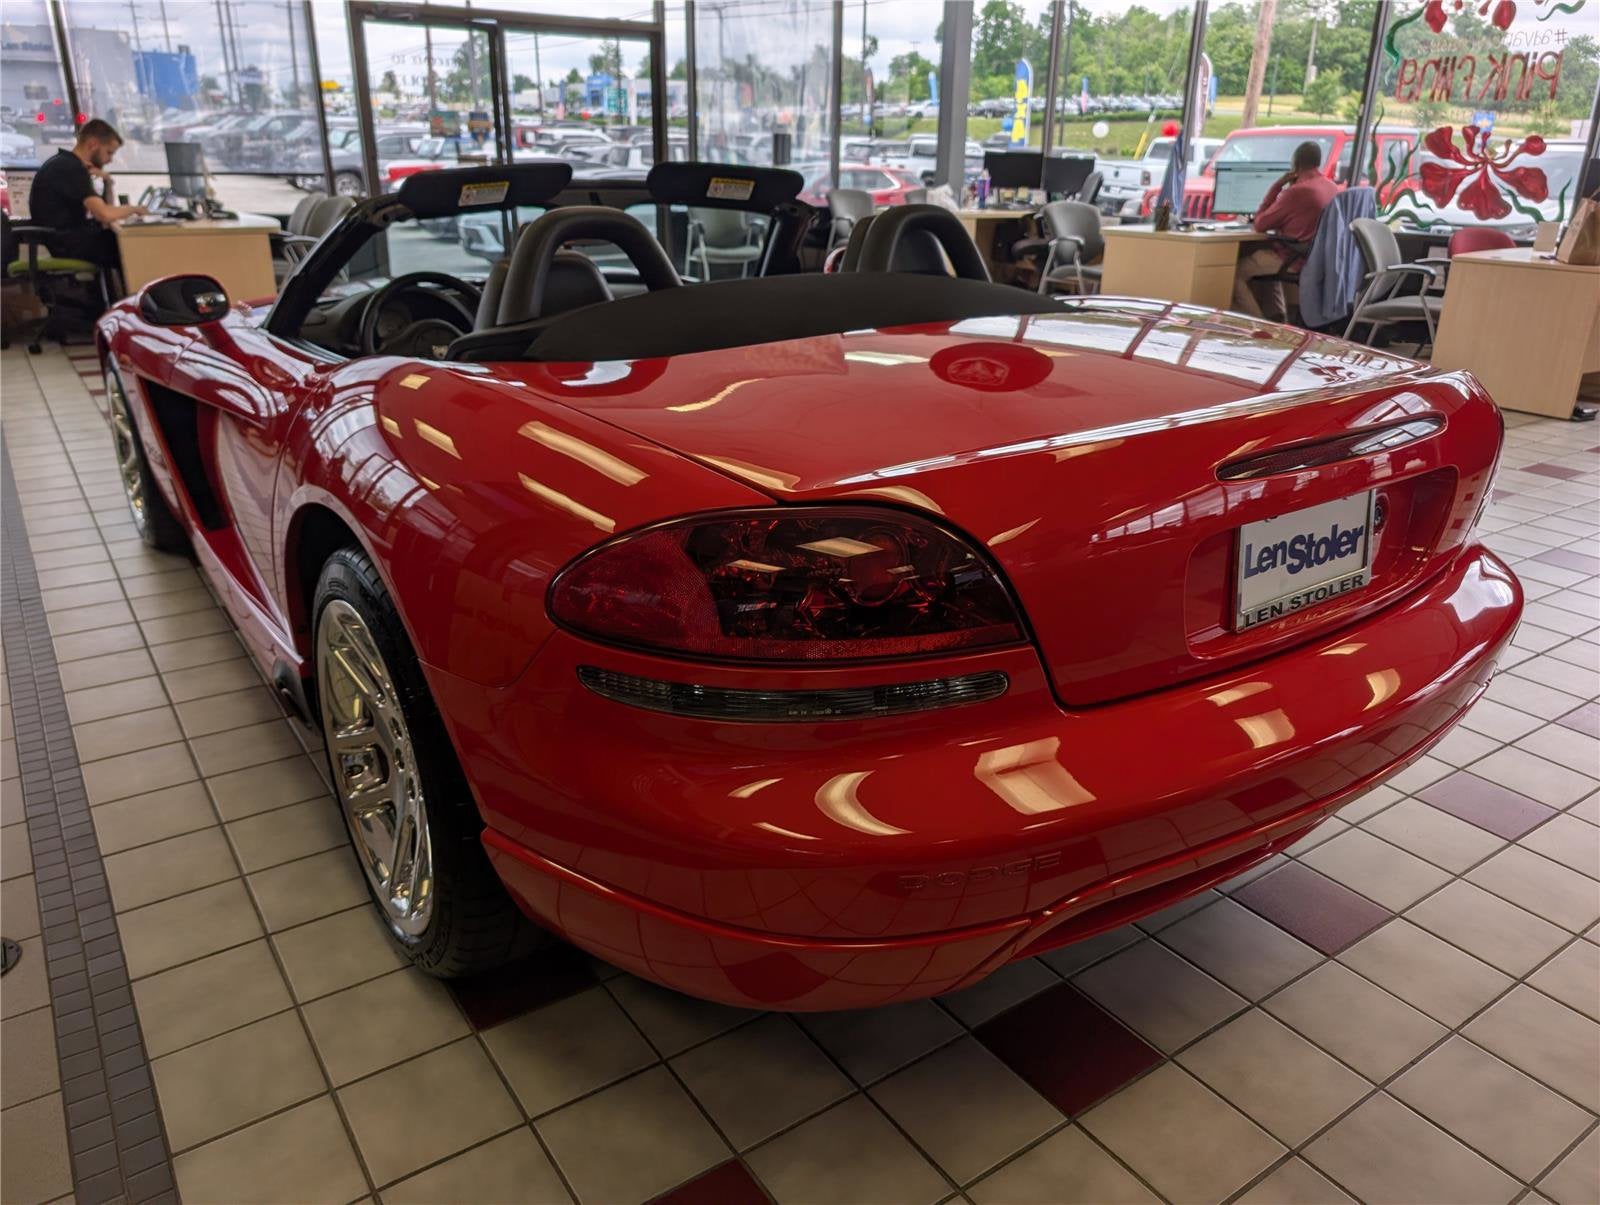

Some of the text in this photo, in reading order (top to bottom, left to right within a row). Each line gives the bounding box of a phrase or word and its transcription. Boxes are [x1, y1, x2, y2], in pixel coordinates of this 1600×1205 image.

[1244, 574, 1364, 628] LEN STOLER
[898, 850, 1062, 889] DODGE
